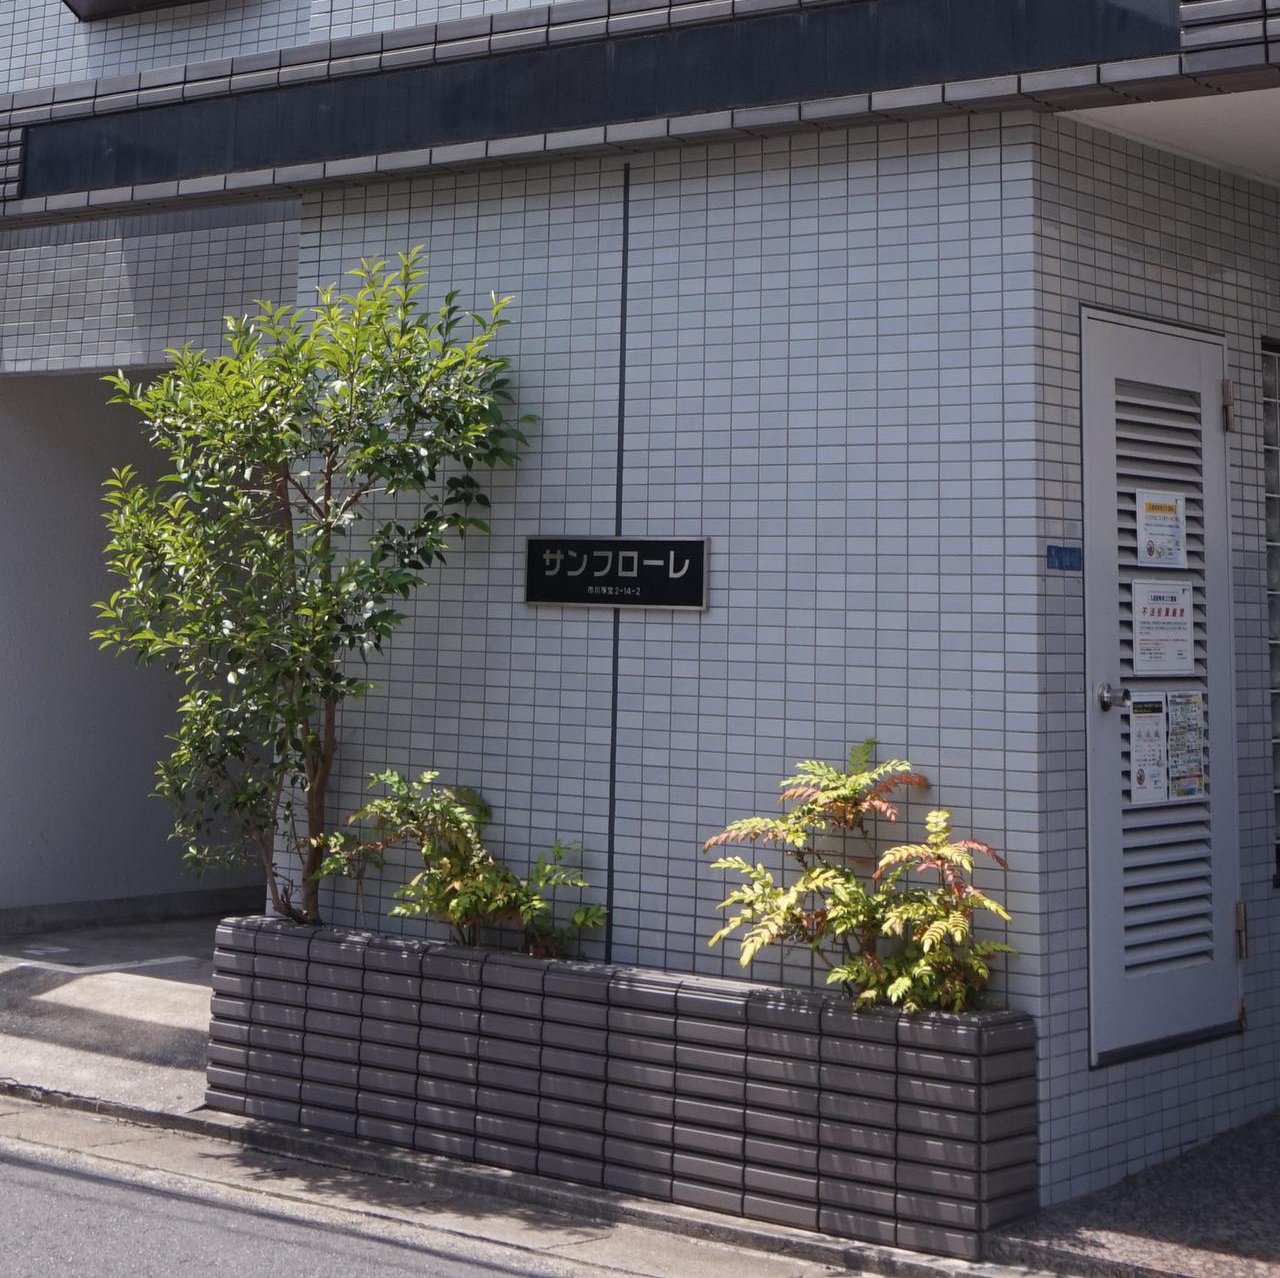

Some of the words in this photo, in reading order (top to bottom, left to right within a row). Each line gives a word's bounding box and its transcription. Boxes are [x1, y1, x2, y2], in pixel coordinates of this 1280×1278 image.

[543, 549, 690, 579] サンフローレ
